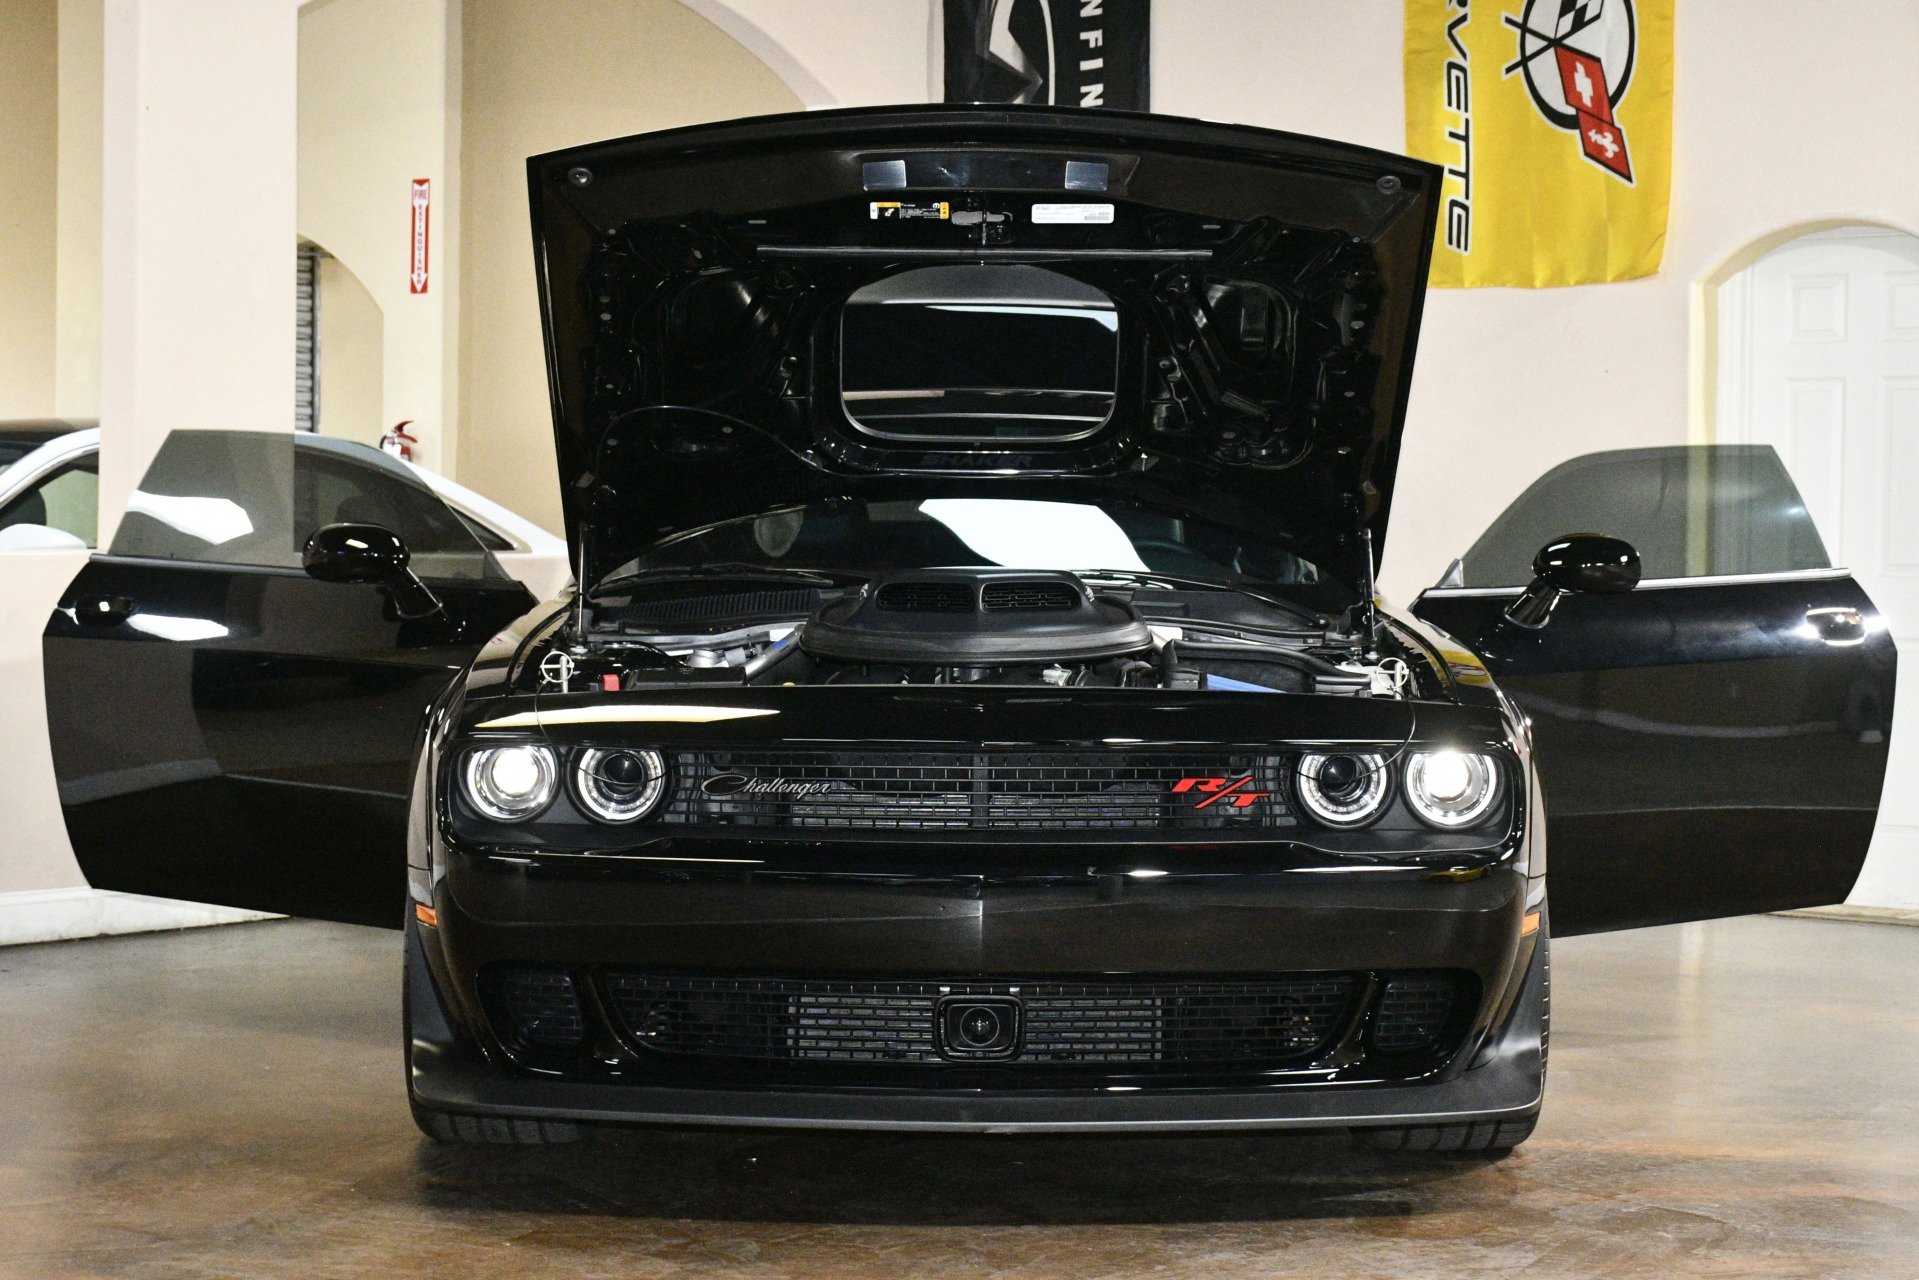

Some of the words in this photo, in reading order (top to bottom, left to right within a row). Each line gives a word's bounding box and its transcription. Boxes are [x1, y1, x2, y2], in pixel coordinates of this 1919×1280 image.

[1446, 0, 1470, 253] VETTE
[414, 189, 428, 200] FIRE
[416, 203, 424, 285] EXTINGUISHER
[920, 454, 1033, 467] SHAKER
[700, 774, 832, 800] Challenger
[1171, 775, 1272, 809] R/T
